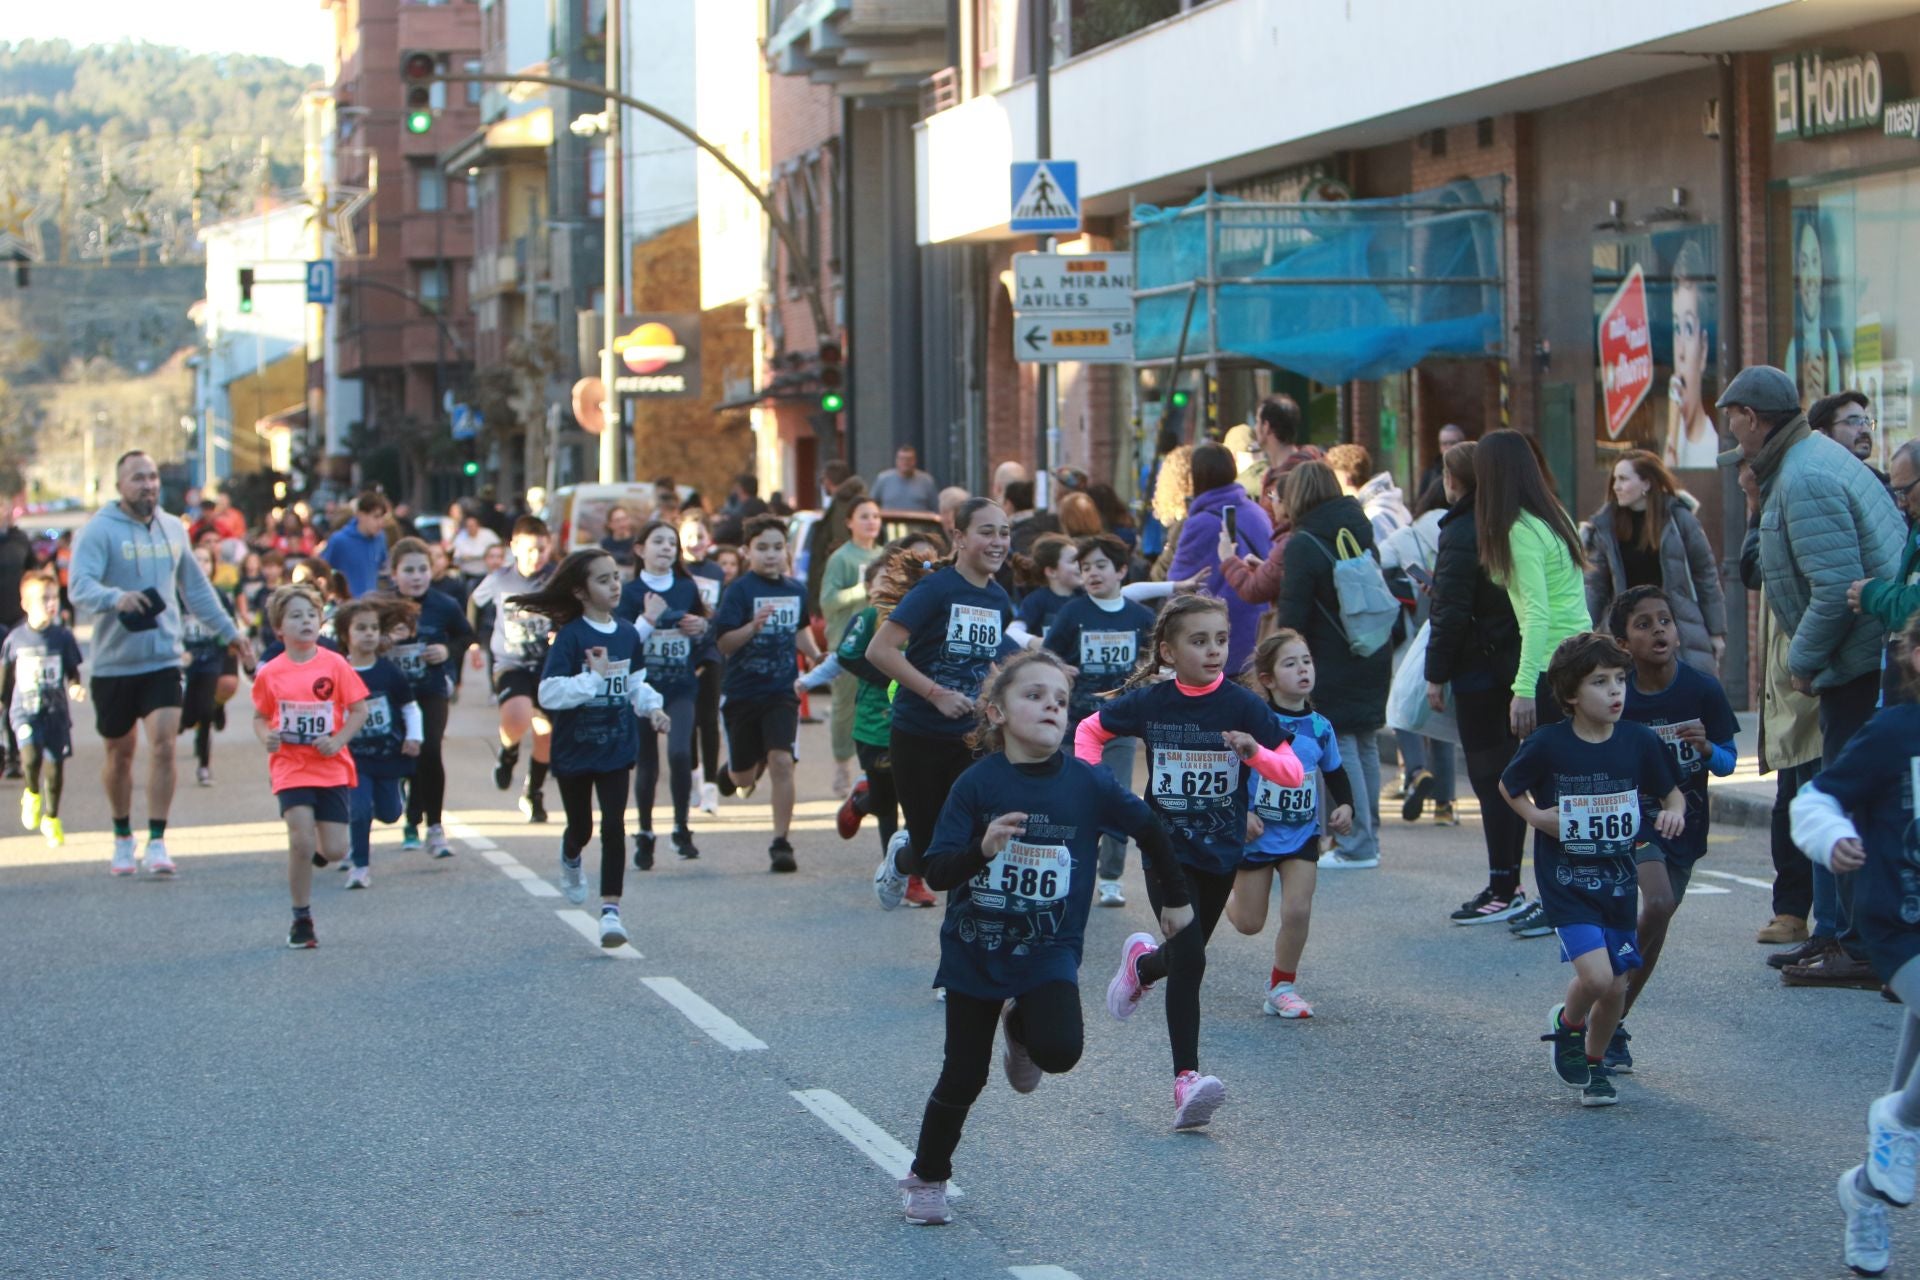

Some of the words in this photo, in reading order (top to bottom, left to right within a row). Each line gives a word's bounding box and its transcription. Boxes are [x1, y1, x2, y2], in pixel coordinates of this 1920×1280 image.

[1774, 61, 1797, 134] El
[1802, 55, 1881, 127] Horno
[1021, 276, 1044, 289] LA
[1022, 293, 1089, 307] AVILES
[969, 623, 996, 645] 668
[1101, 646, 1130, 664] 520
[297, 717, 326, 734] 519
[1184, 723, 1200, 732] 2024
[1167, 752, 1182, 760] SAN
[1186, 752, 1228, 763] SILVESTRE
[1181, 771, 1228, 797] 625
[1278, 789, 1311, 810] 638
[1572, 798, 1588, 807] SAN
[1029, 814, 1049, 823] 2024
[1589, 812, 1632, 841] 568
[1011, 843, 1057, 859] SILVESTRE
[1001, 864, 1058, 898] 586
